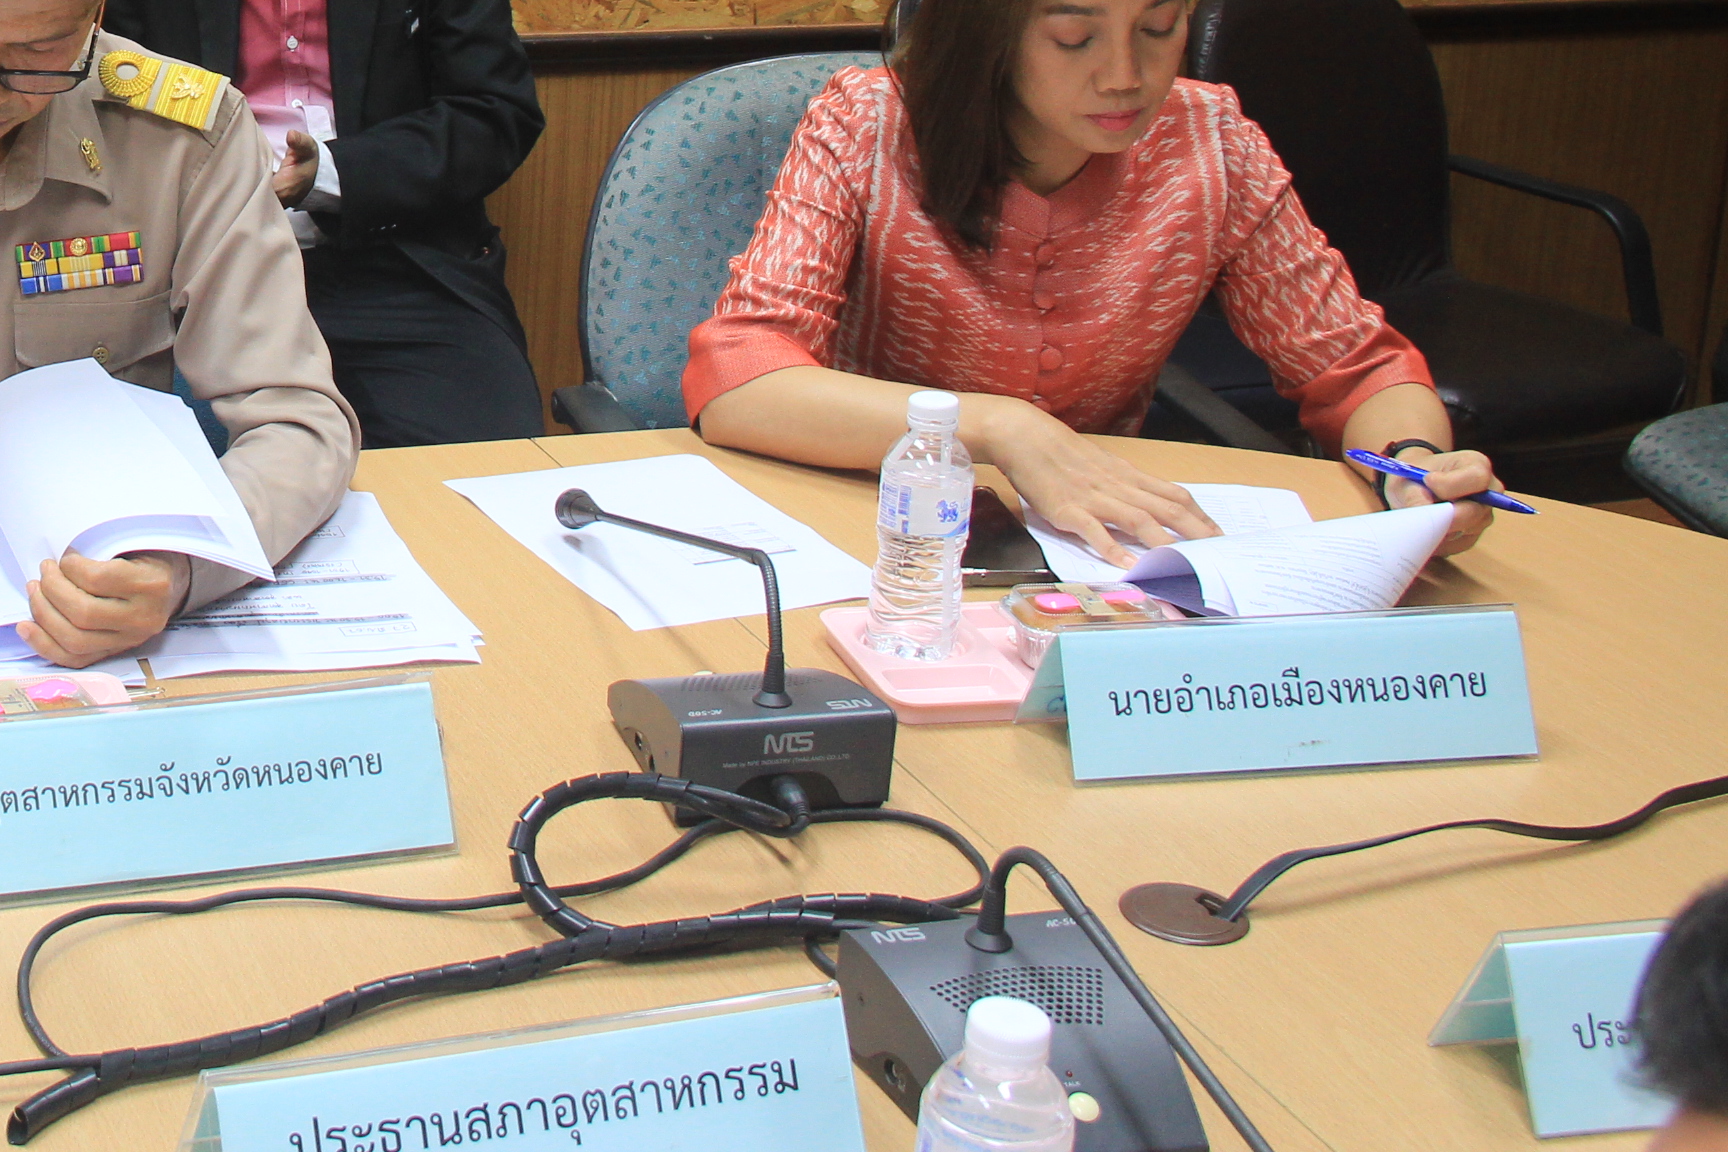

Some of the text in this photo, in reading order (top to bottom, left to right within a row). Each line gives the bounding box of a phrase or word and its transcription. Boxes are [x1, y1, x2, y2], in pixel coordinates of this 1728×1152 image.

[1107, 666, 1488, 717] นายอำเภอเมืองหนองคาย
[763, 731, 815, 755] NTS
[871, 926, 927, 945] NTS
[1572, 1012, 1633, 1049] ประ
[289, 1056, 801, 1152] ประธานสภาอุตสาหกรรม
